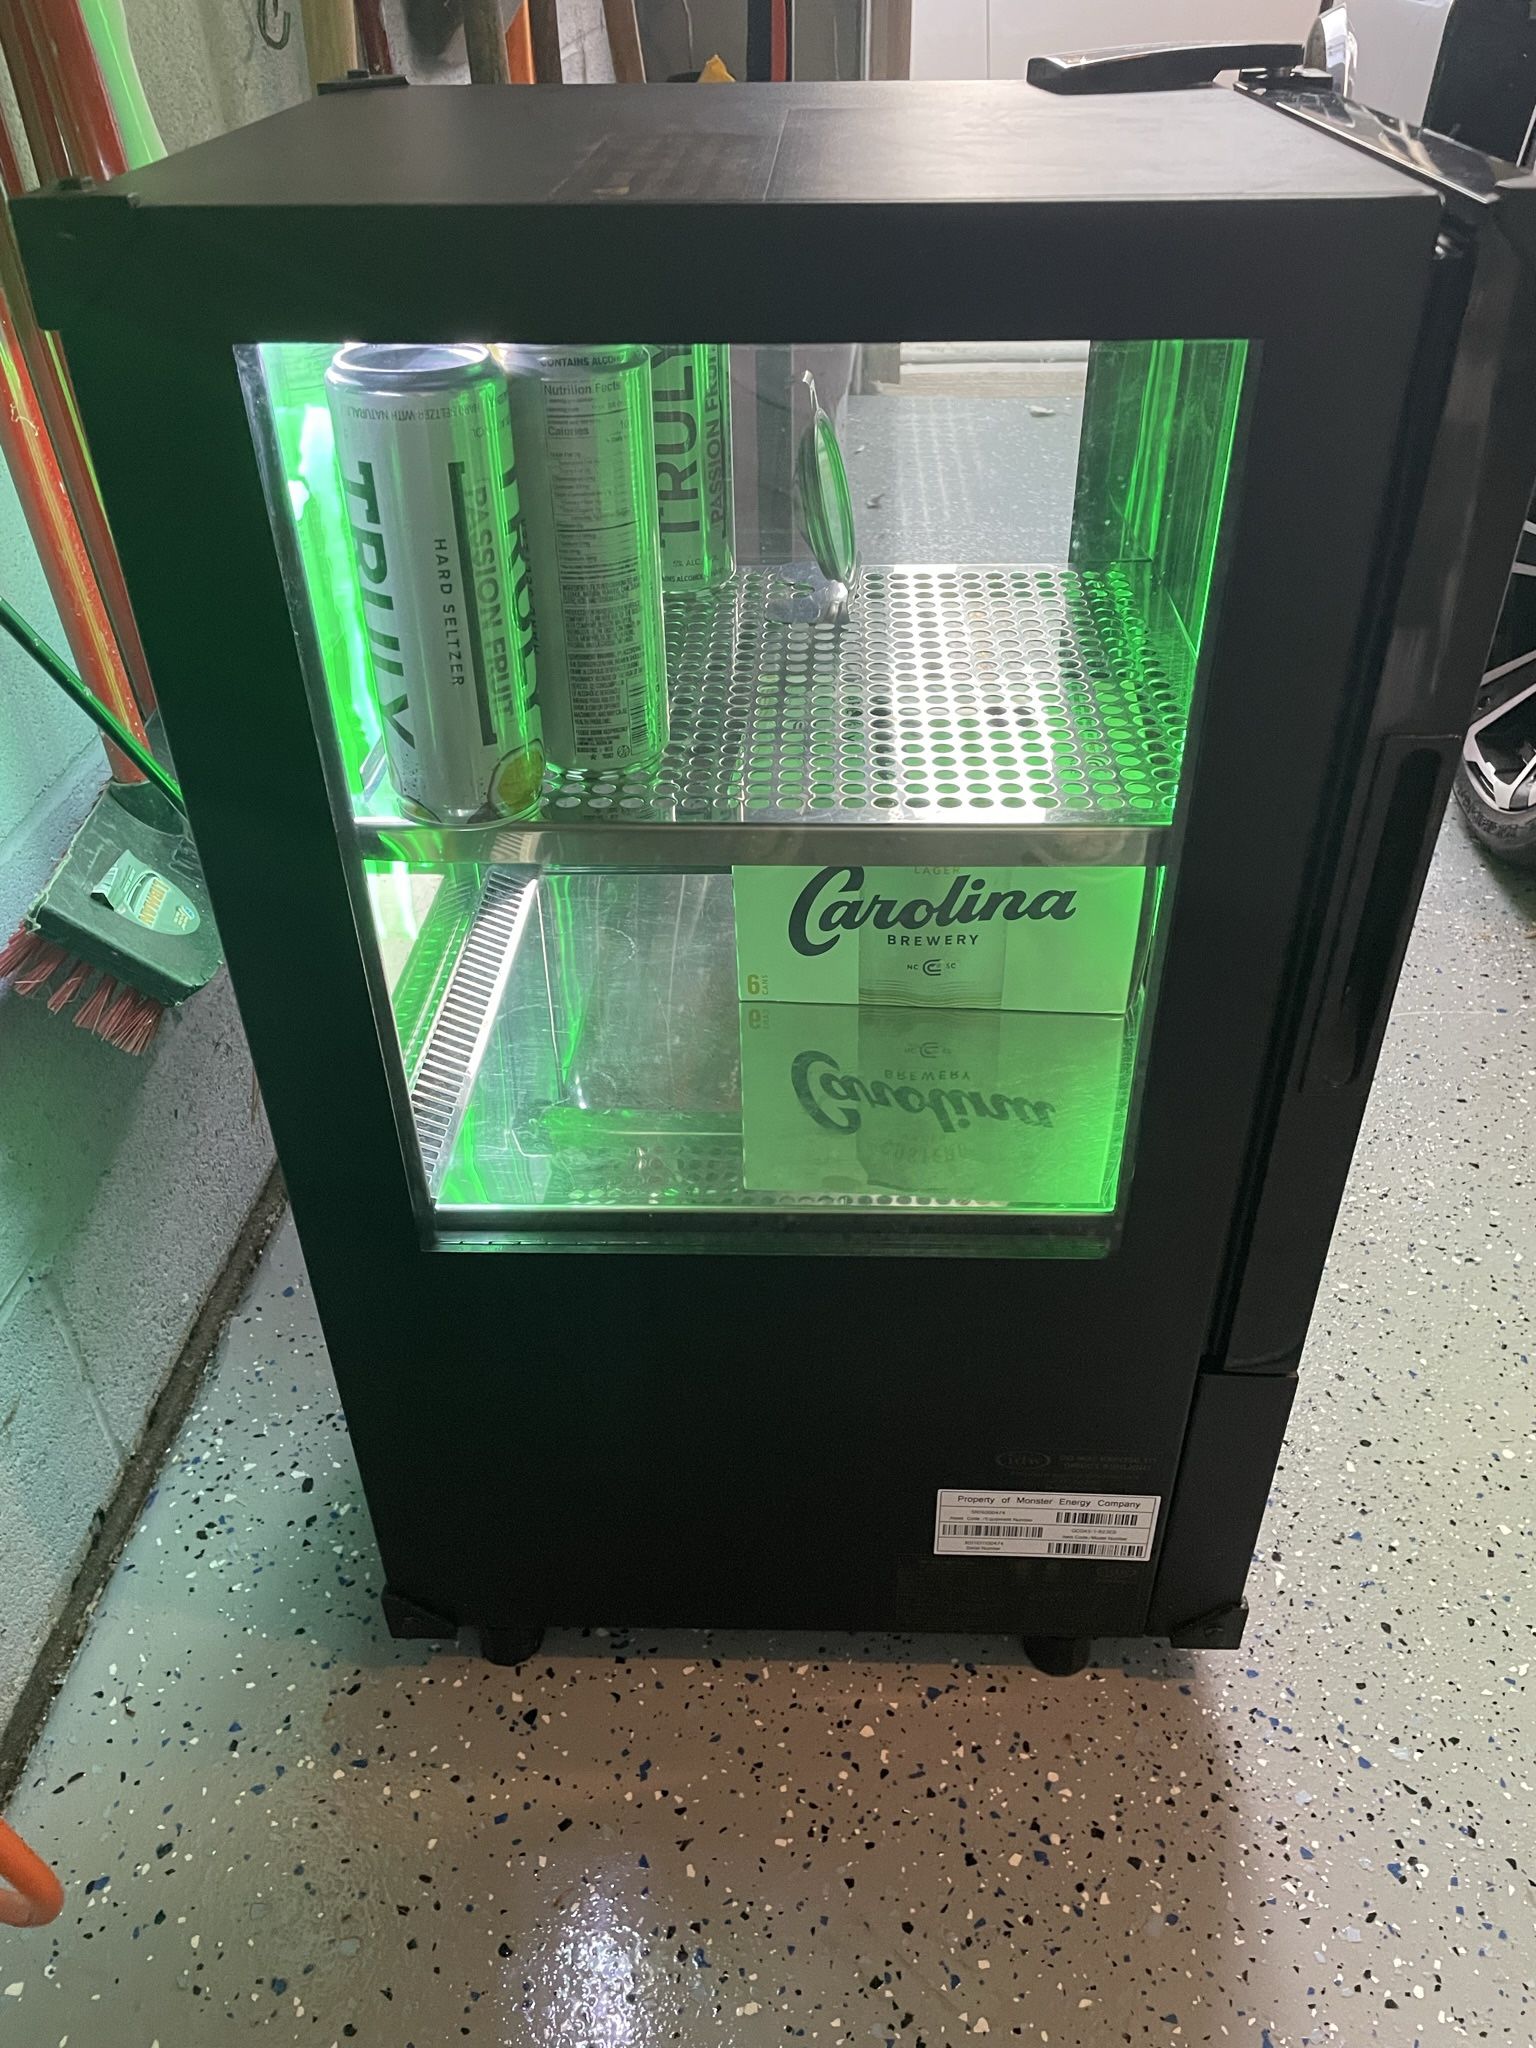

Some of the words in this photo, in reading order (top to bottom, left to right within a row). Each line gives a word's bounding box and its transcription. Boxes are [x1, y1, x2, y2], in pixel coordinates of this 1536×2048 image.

[544, 384, 592, 396] Nutrition
[595, 381, 621, 393] Facts
[651, 344, 700, 548] TRULY
[705, 418, 724, 525] PASSION
[435, 539, 453, 594] HARD
[465, 483, 503, 630] PASSION
[443, 604, 465, 687] SELTZER
[913, 866, 961, 875] LAGER
[788, 865, 1078, 957] Carolina
[887, 934, 980, 947] BREWERY
[746, 973, 761, 995] 6
[906, 963, 919, 971] NC
[957, 1495, 996, 1505] Property
[1001, 1496, 1011, 1504] of
[1016, 1496, 1053, 1505] Monster
[1058, 1498, 1091, 1508] Energy
[1097, 1499, 1141, 1509] Company
